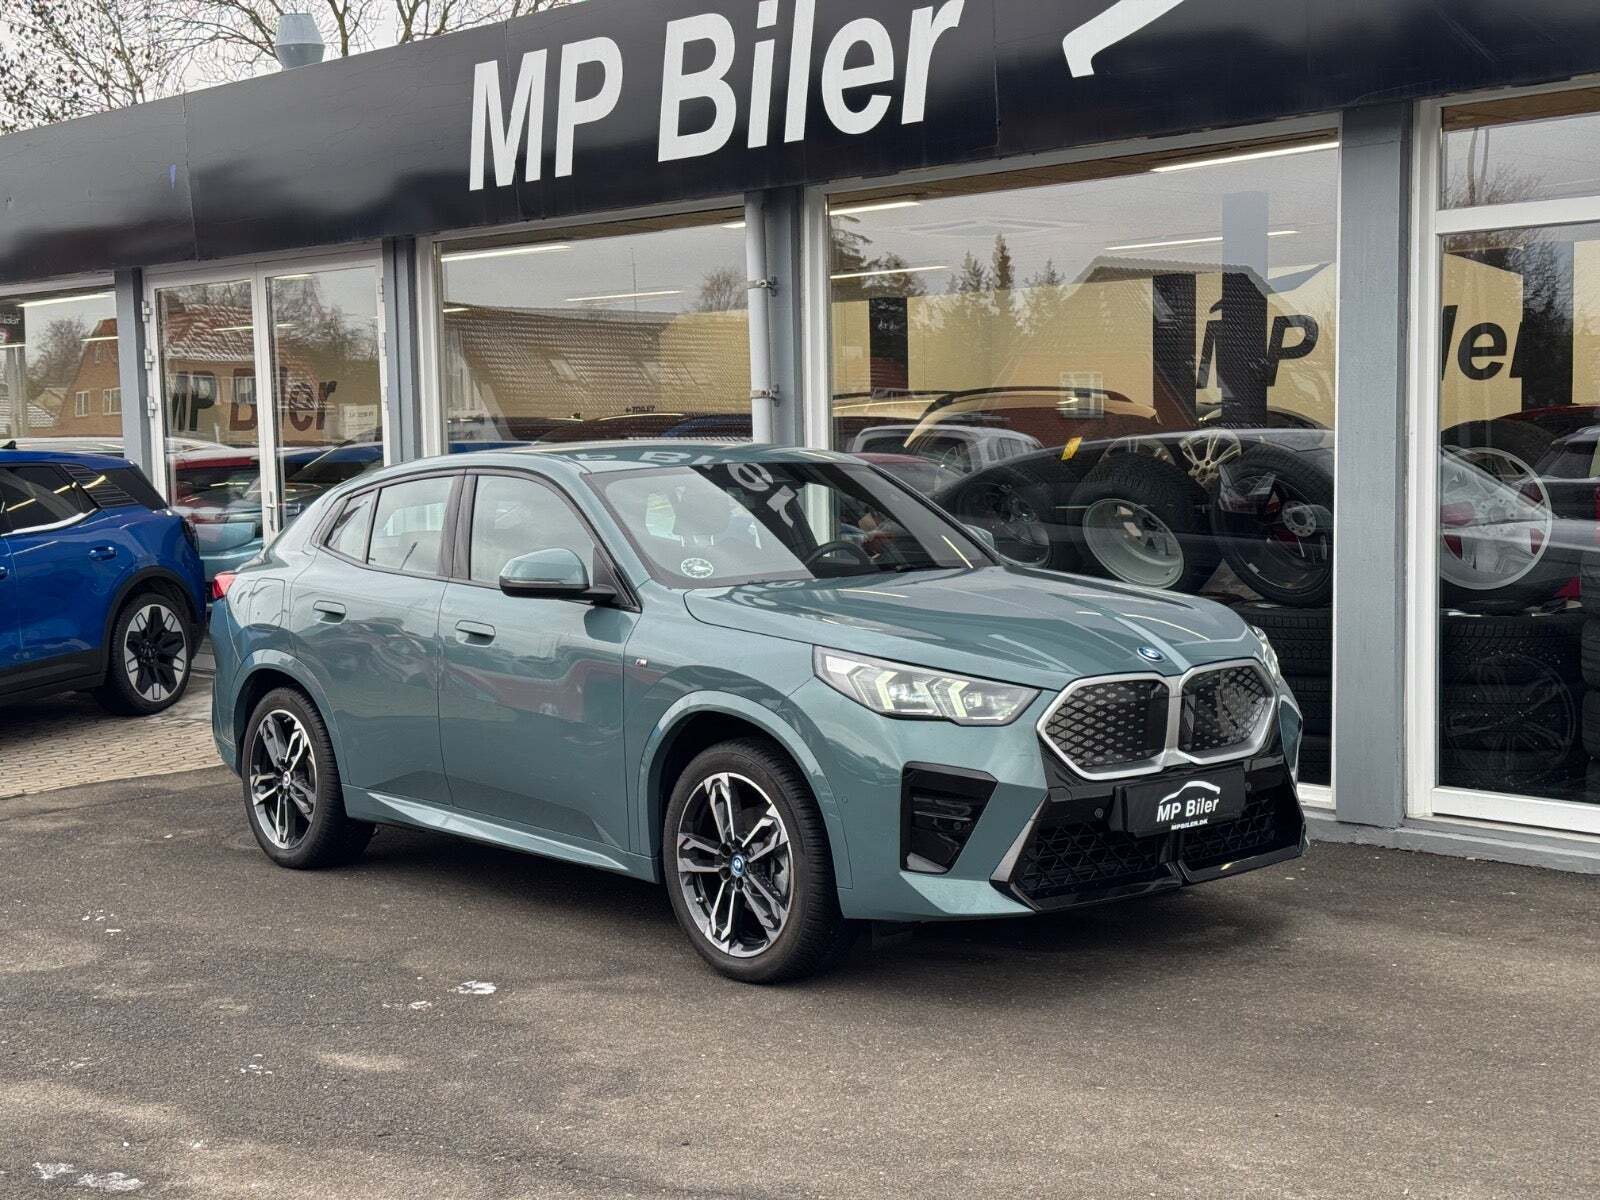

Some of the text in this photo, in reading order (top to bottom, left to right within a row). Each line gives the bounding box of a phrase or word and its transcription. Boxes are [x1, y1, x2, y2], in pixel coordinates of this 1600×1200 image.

[469, 0, 964, 191] MP Biler
[1157, 797, 1219, 822] MP Biler
